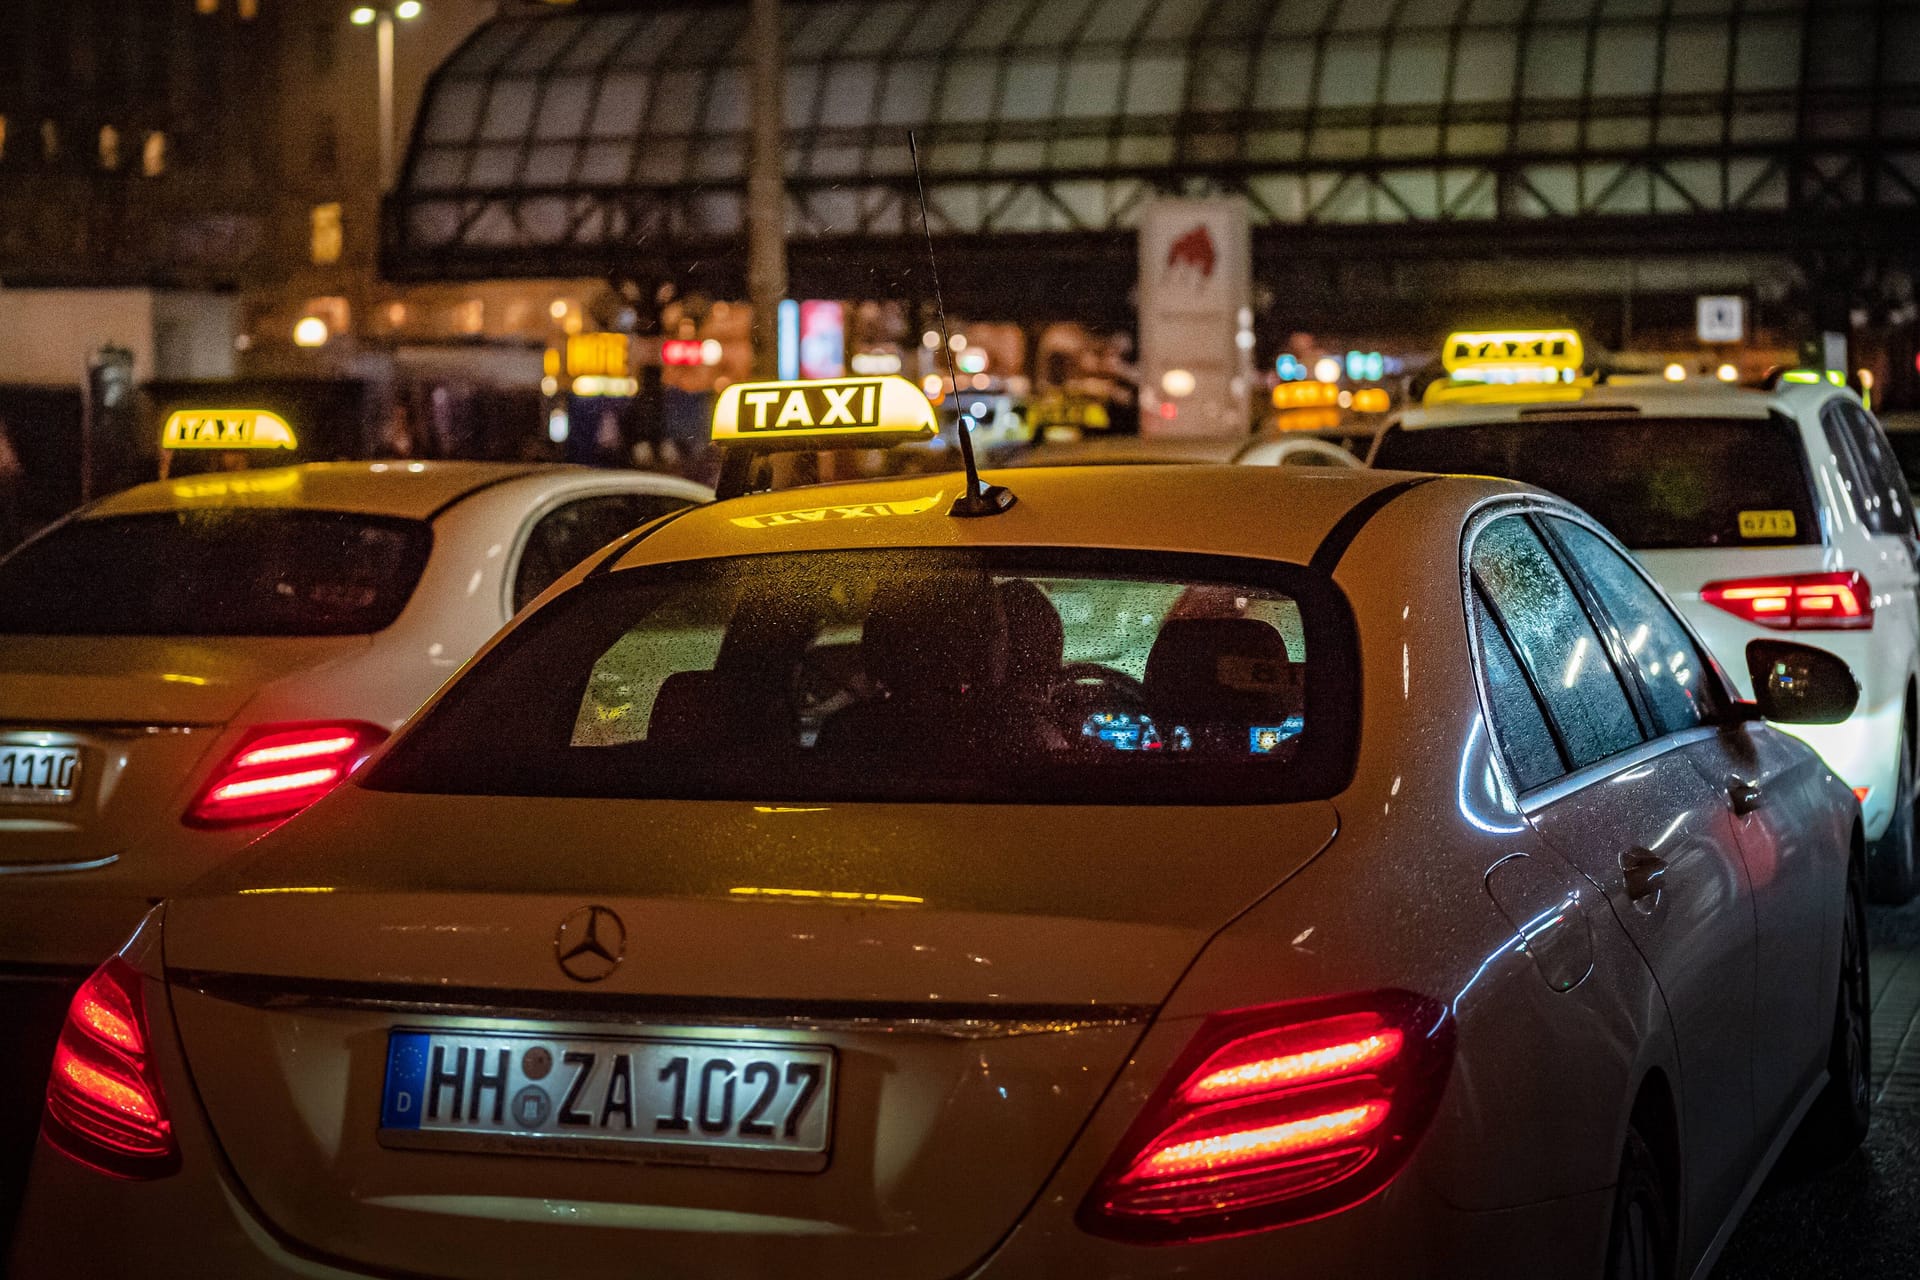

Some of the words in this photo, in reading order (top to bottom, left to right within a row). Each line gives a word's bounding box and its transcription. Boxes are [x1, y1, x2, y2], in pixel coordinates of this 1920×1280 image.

[744, 386, 876, 429] TAXI
[181, 417, 251, 441] TAXI
[0, 752, 76, 789] 1110
[396, 1090, 411, 1113] D
[427, 1045, 511, 1123] HH
[557, 1051, 635, 1130] ZA
[654, 1056, 823, 1138] 1027
